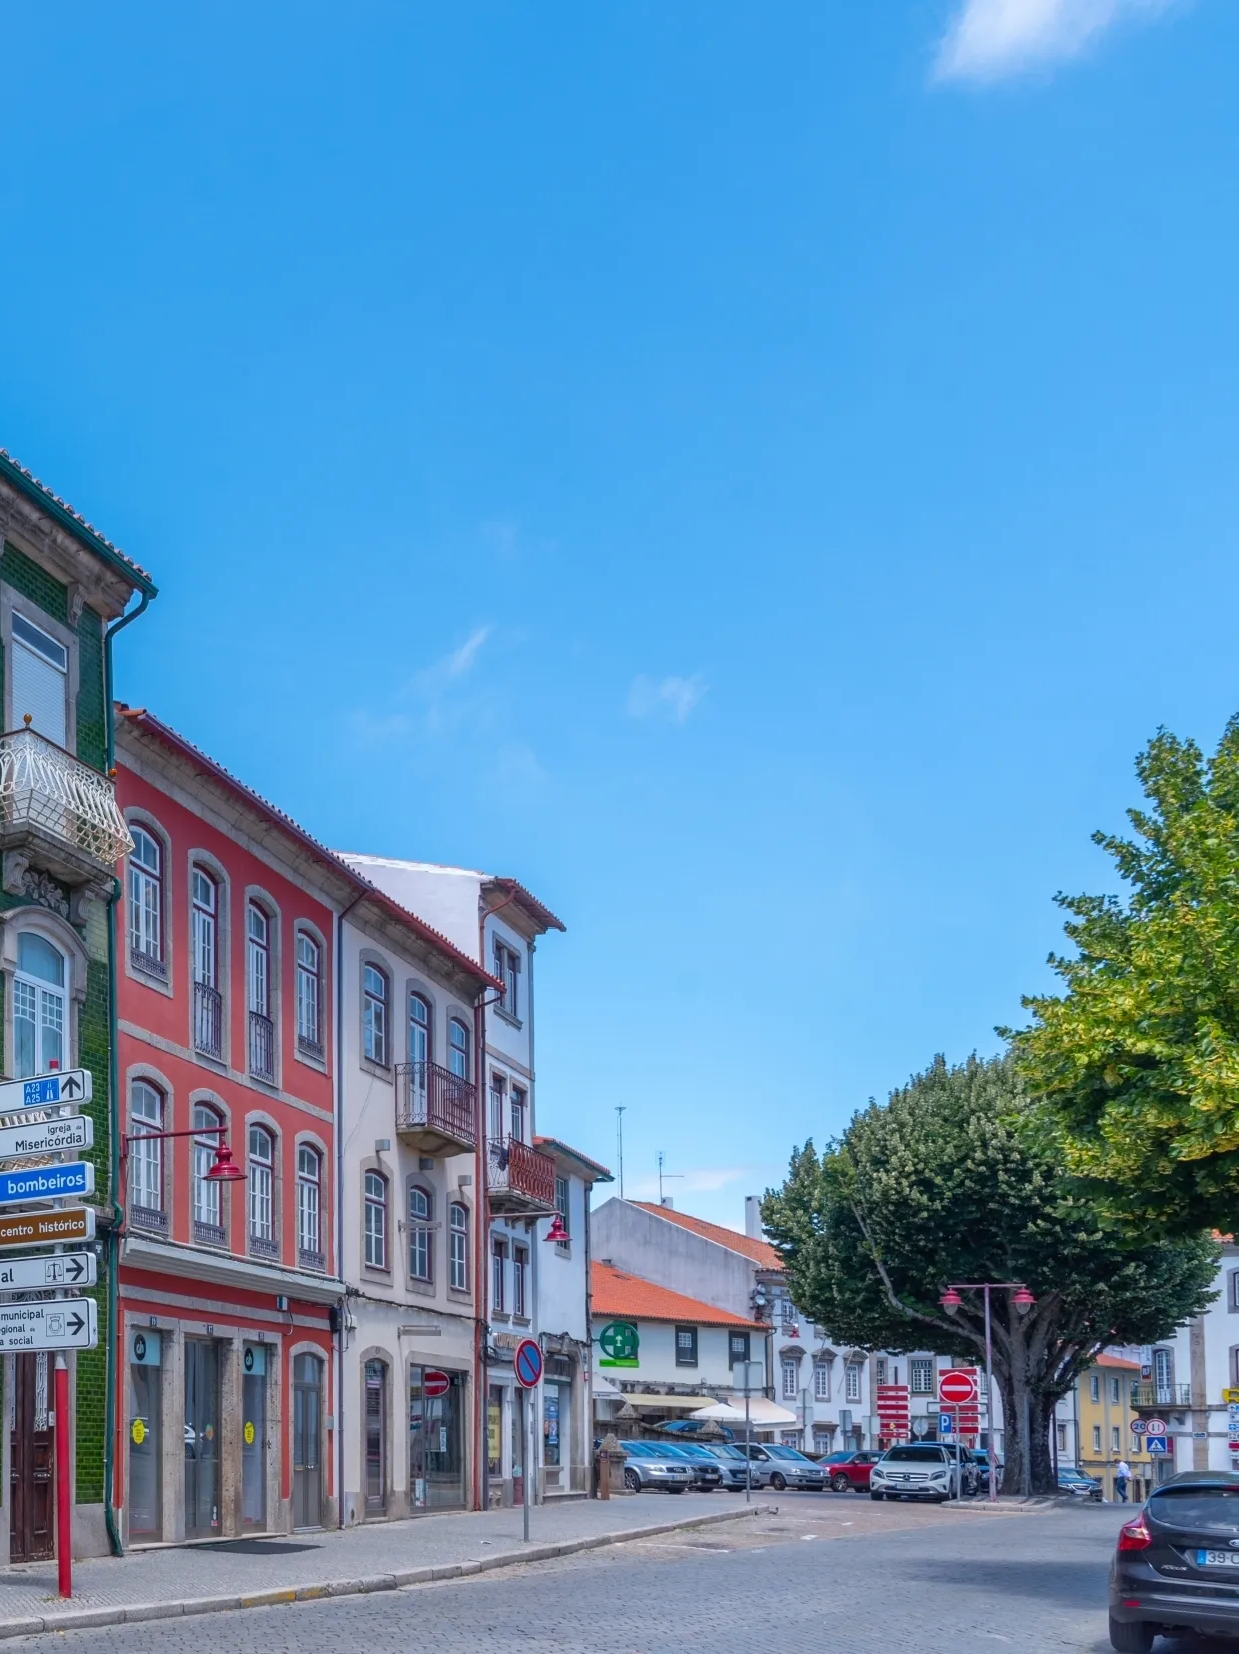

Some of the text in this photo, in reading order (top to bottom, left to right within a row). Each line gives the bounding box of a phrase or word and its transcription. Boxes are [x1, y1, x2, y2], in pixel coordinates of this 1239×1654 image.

[25, 1083, 40, 1094] A23
[25, 1096, 40, 1105] A25
[15, 1133, 82, 1152] Misericórdia
[7, 1173, 84, 1194] bombeiros
[0, 1219, 85, 1237] centro histórico
[0, 1308, 45, 1321] municipal
[8, 1335, 34, 1346] social
[1133, 1422, 1146, 1430] 20
